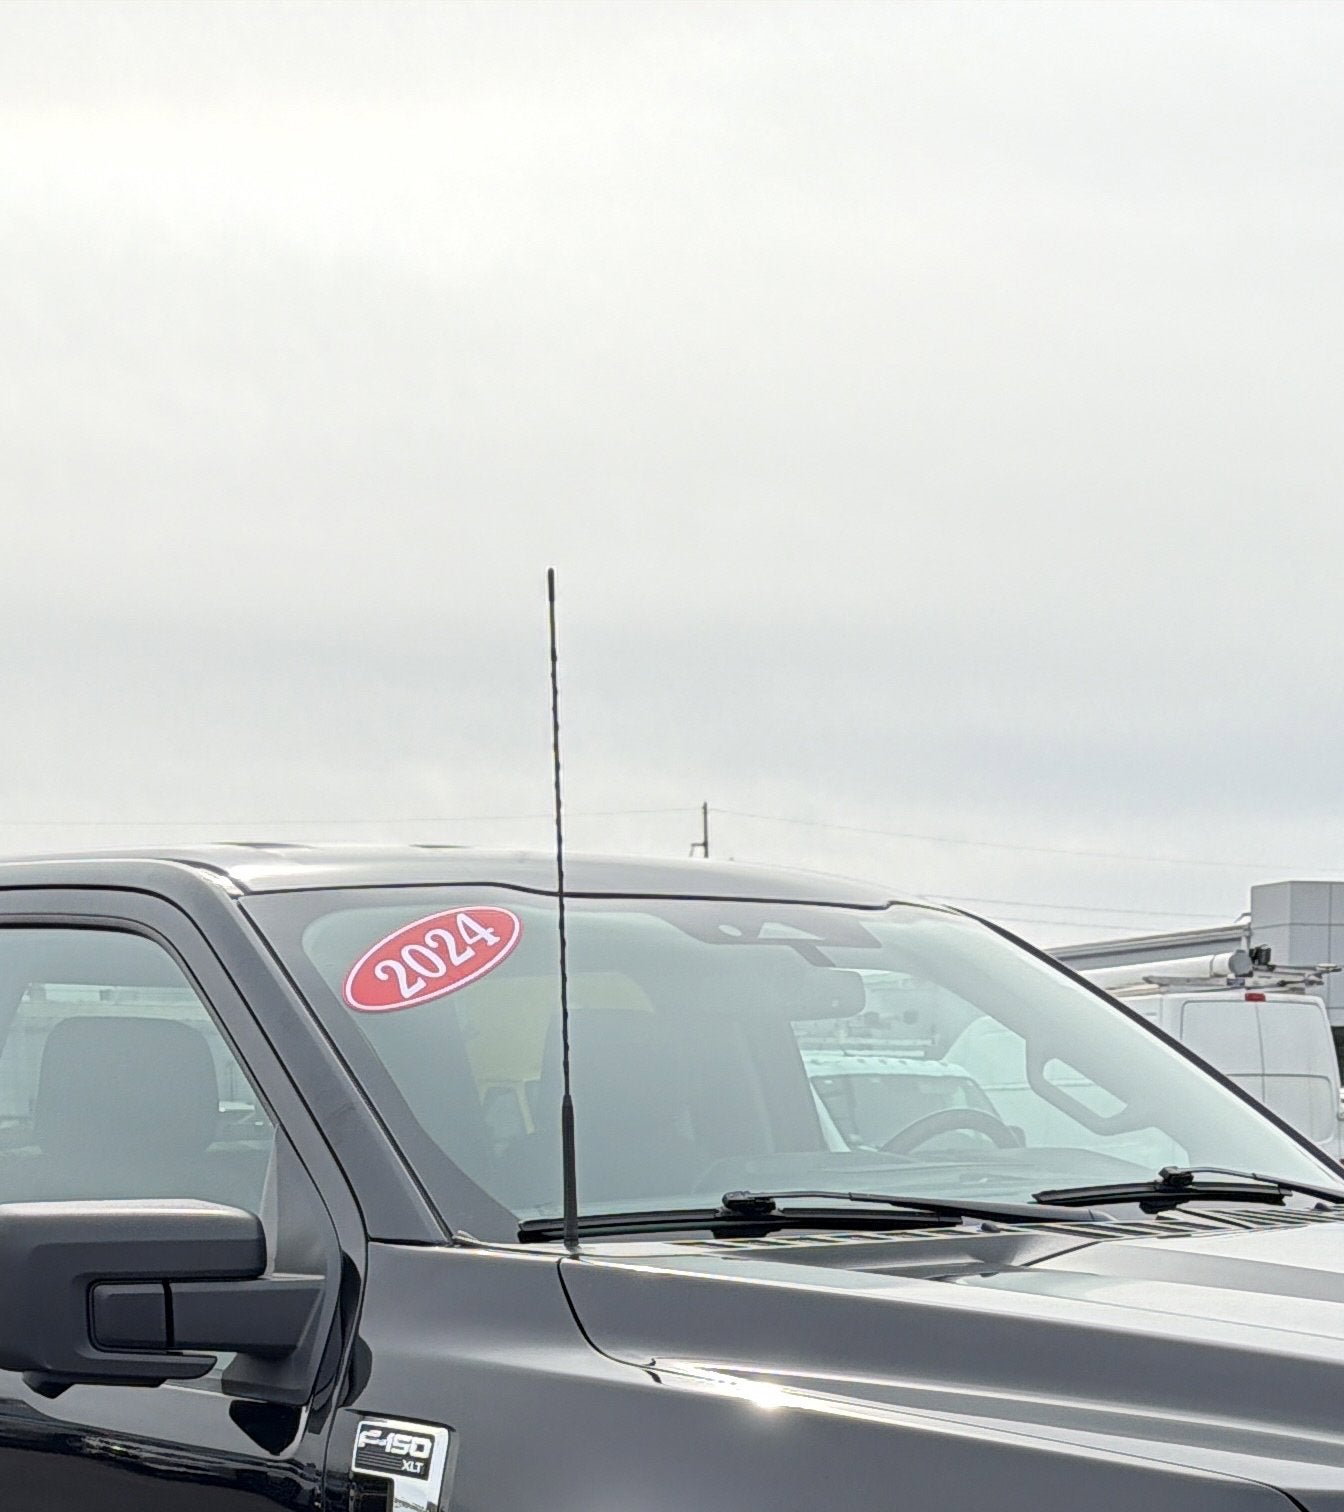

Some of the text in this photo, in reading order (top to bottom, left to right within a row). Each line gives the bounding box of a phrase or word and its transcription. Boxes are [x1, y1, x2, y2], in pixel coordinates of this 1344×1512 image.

[374, 913, 500, 998] 2024
[358, 1429, 432, 1459] F-150
[401, 1459, 424, 1474] XLT
